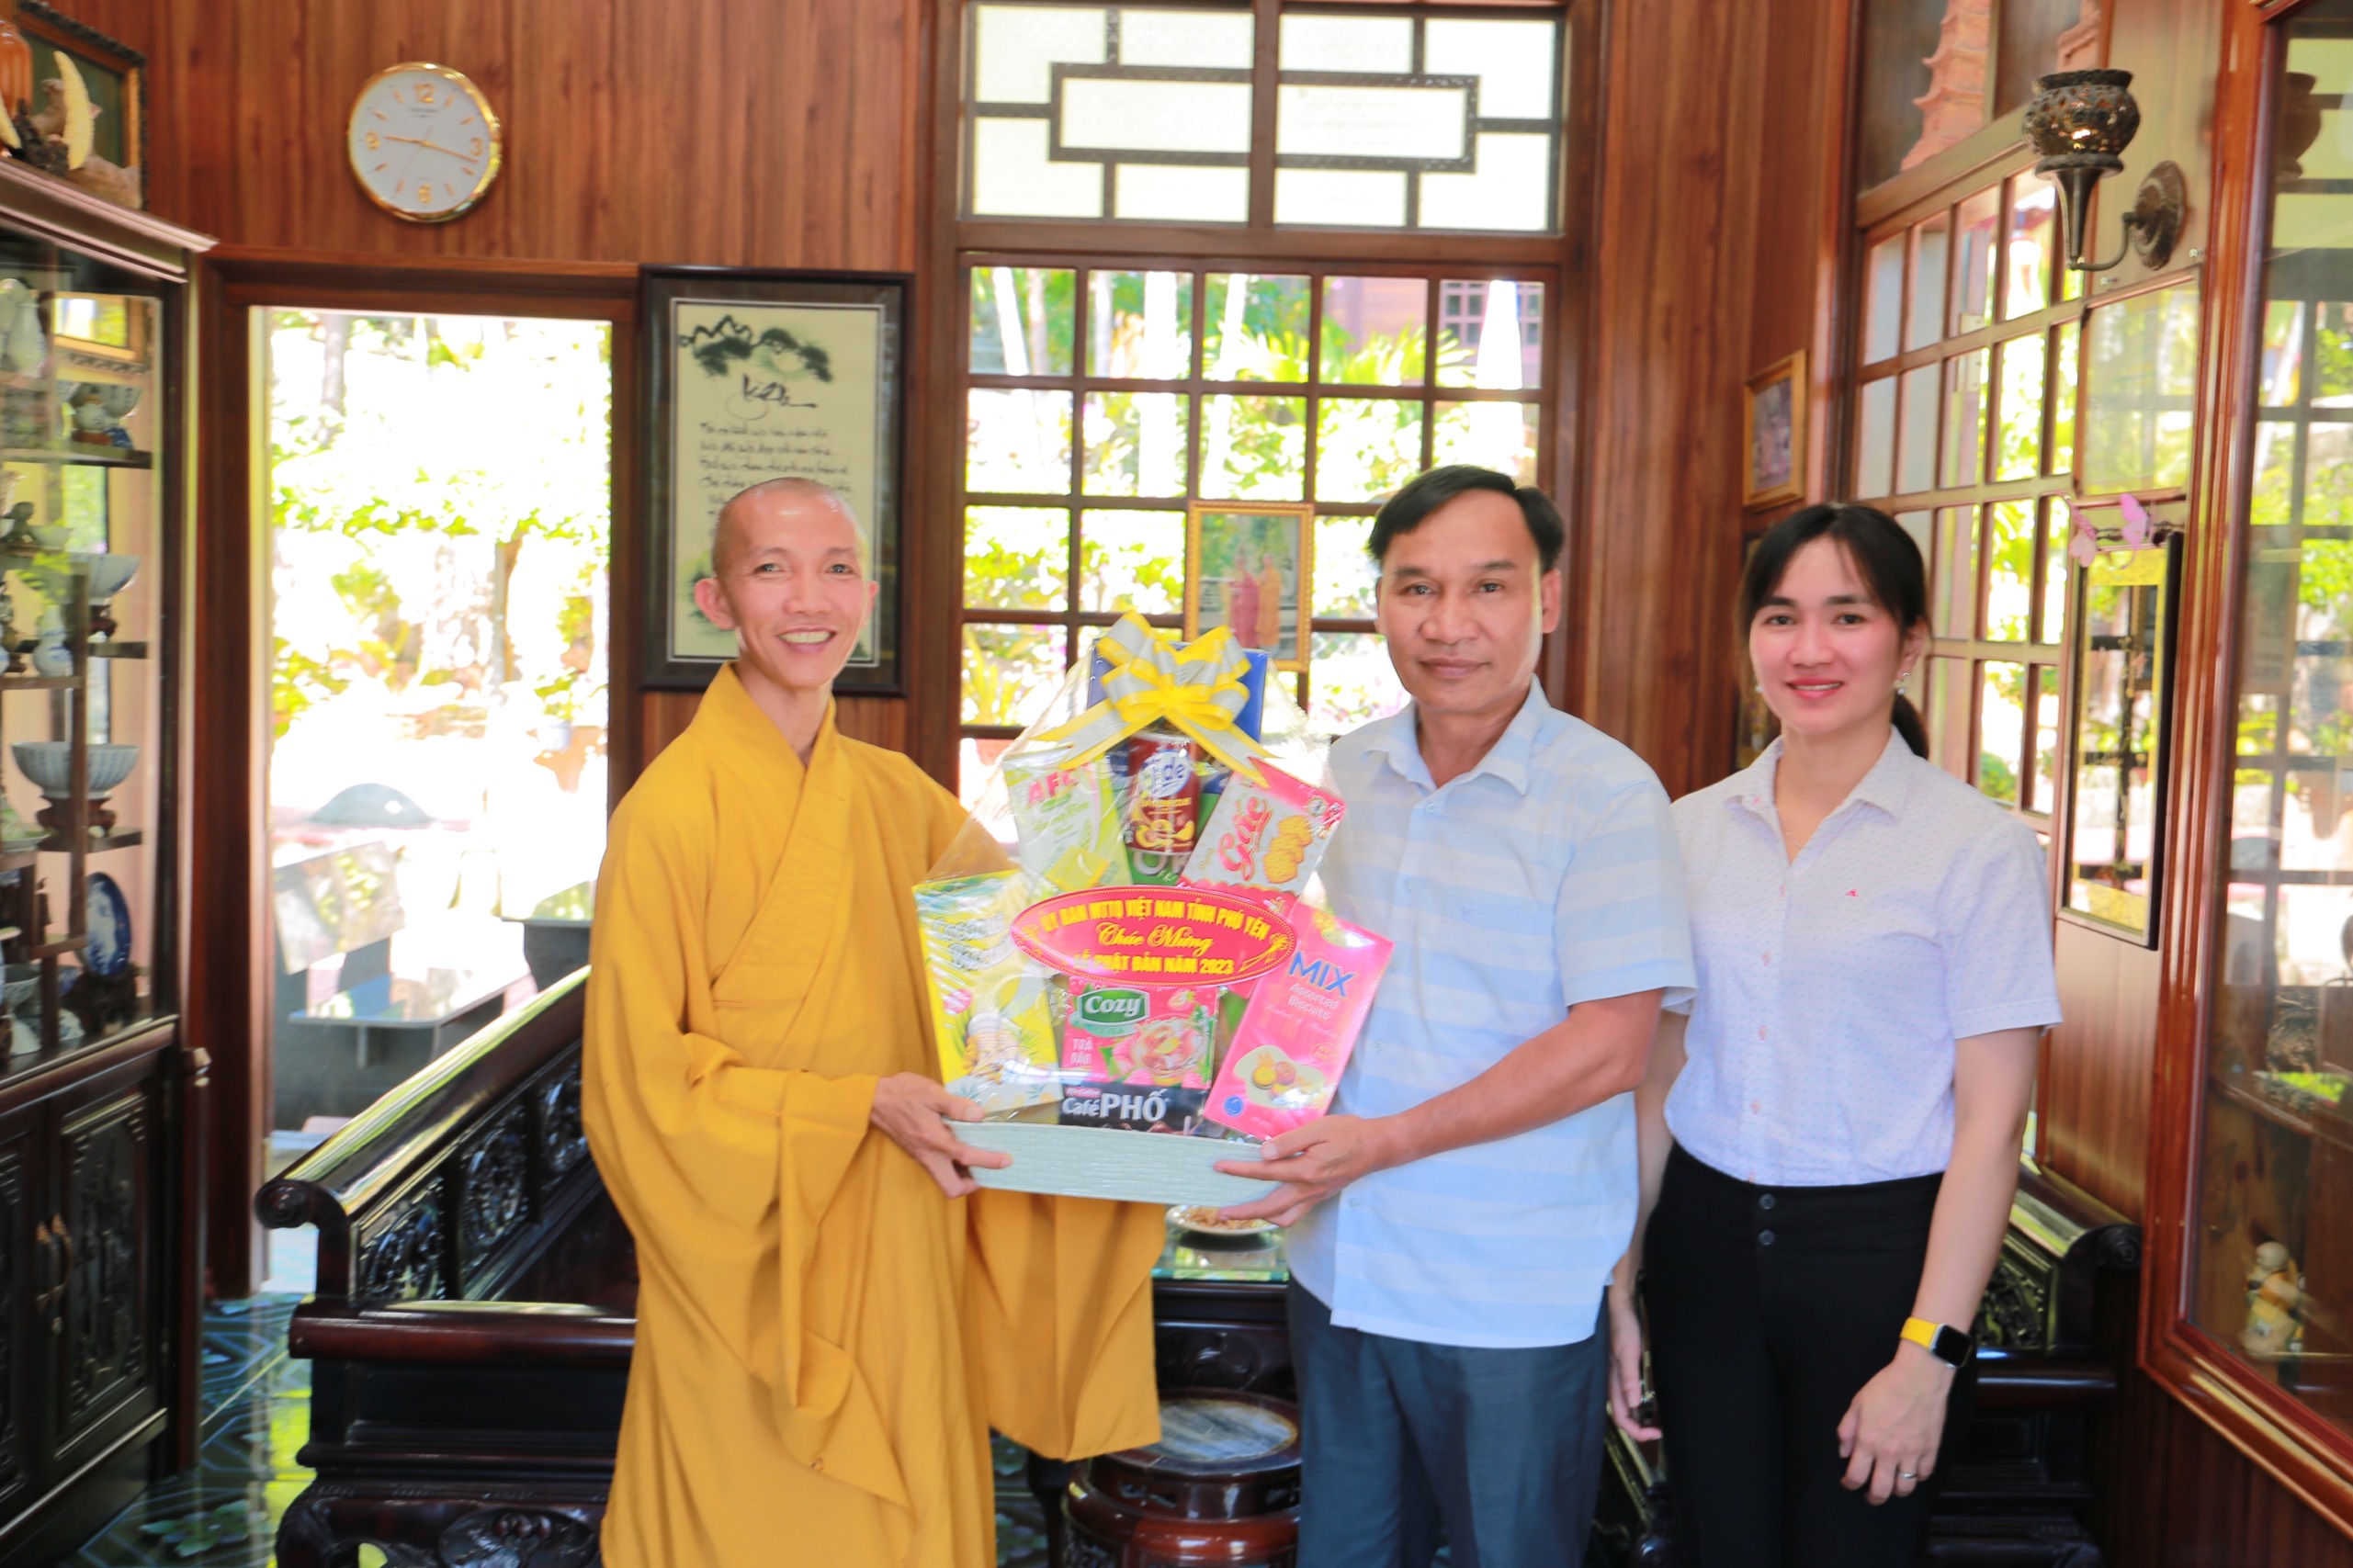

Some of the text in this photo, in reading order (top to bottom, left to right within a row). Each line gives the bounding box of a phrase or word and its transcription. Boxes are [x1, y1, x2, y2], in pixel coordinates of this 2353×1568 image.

[413, 83, 436, 103] 12
[365, 130, 380, 151] 9
[469, 138, 483, 156] 3
[1058, 903, 1088, 926] BAN
[1088, 899, 1124, 919] MTTQ
[1124, 896, 1154, 921] VIỆT
[1154, 899, 1185, 919] NAM
[1186, 897, 1217, 924] TỈNH
[1216, 908, 1245, 931] PHÚ
[1243, 915, 1273, 942] YÊN
[1096, 921, 1214, 957] Chúc Mừng
[1093, 952, 1130, 974] PHẬT
[1163, 954, 1198, 974] NĂM
[1198, 957, 1235, 975] 2023
[1287, 950, 1356, 998] MIX
[1084, 996, 1143, 1017] Cozy
[1062, 1089, 1167, 1122] Café PHỐ
